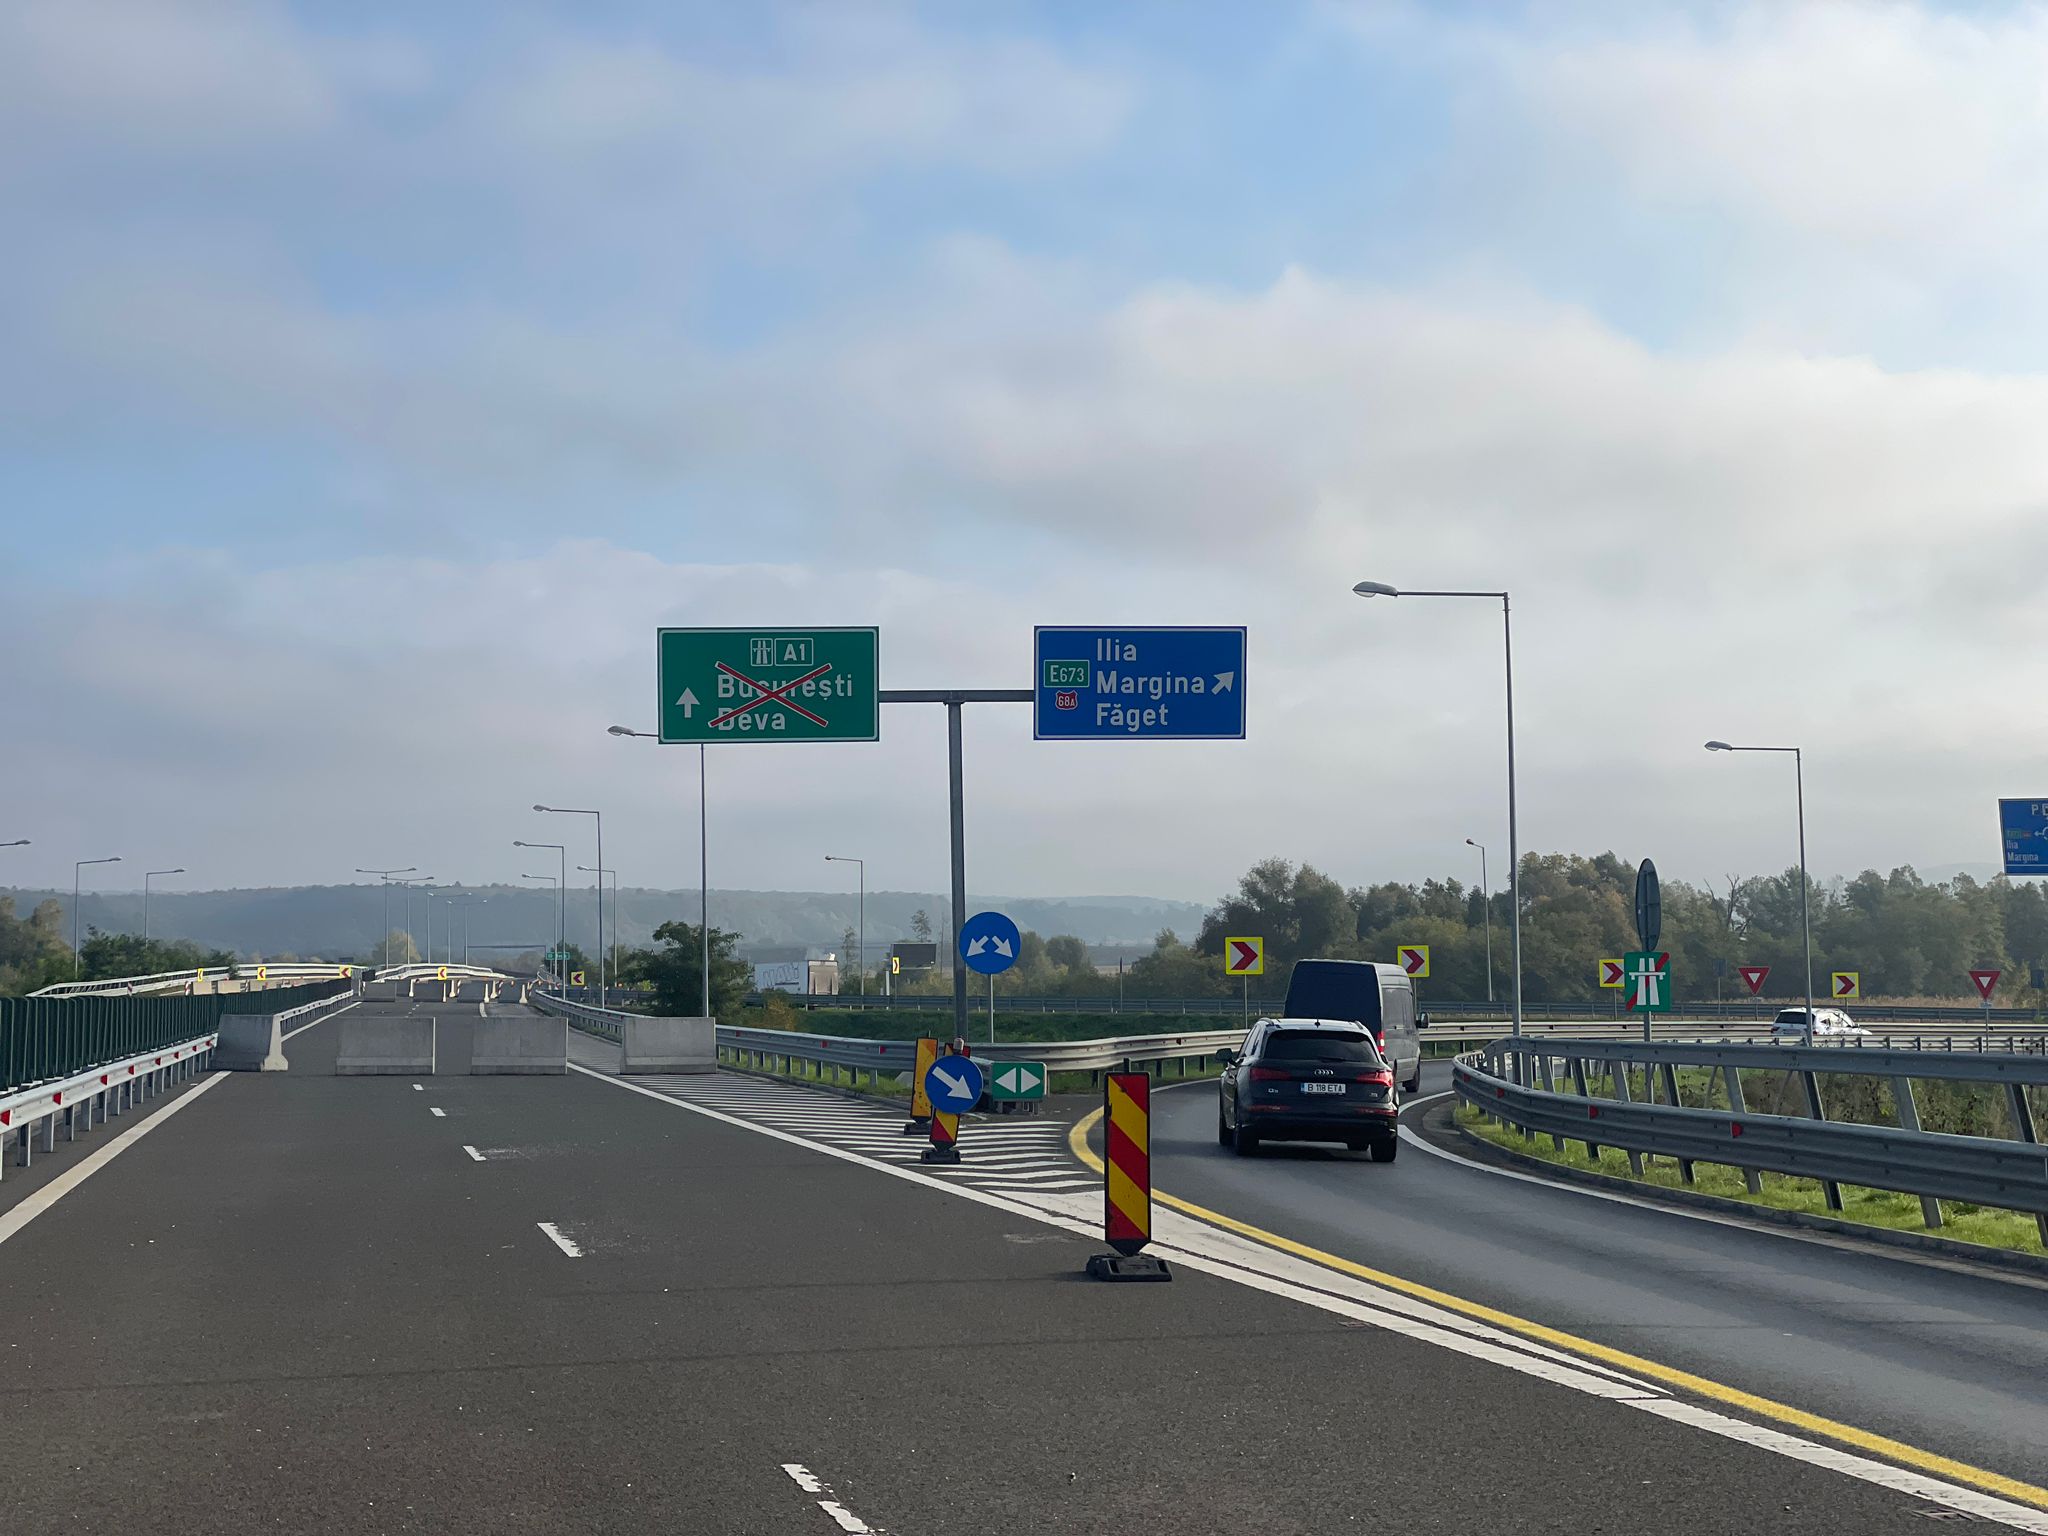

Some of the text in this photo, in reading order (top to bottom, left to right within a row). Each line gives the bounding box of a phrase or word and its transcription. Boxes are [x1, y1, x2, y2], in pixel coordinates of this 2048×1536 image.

[783, 643, 806, 661] A1
[1097, 638, 1137, 661] Ilia
[1050, 664, 1085, 683] E673
[1096, 670, 1205, 700] Margina
[1058, 696, 1075, 707] 68A
[718, 707, 786, 731] Deva
[1096, 703, 1169, 732] Făget
[2007, 852, 2039, 864] Margina
[1307, 1083, 1342, 1092] B 118 ETA
